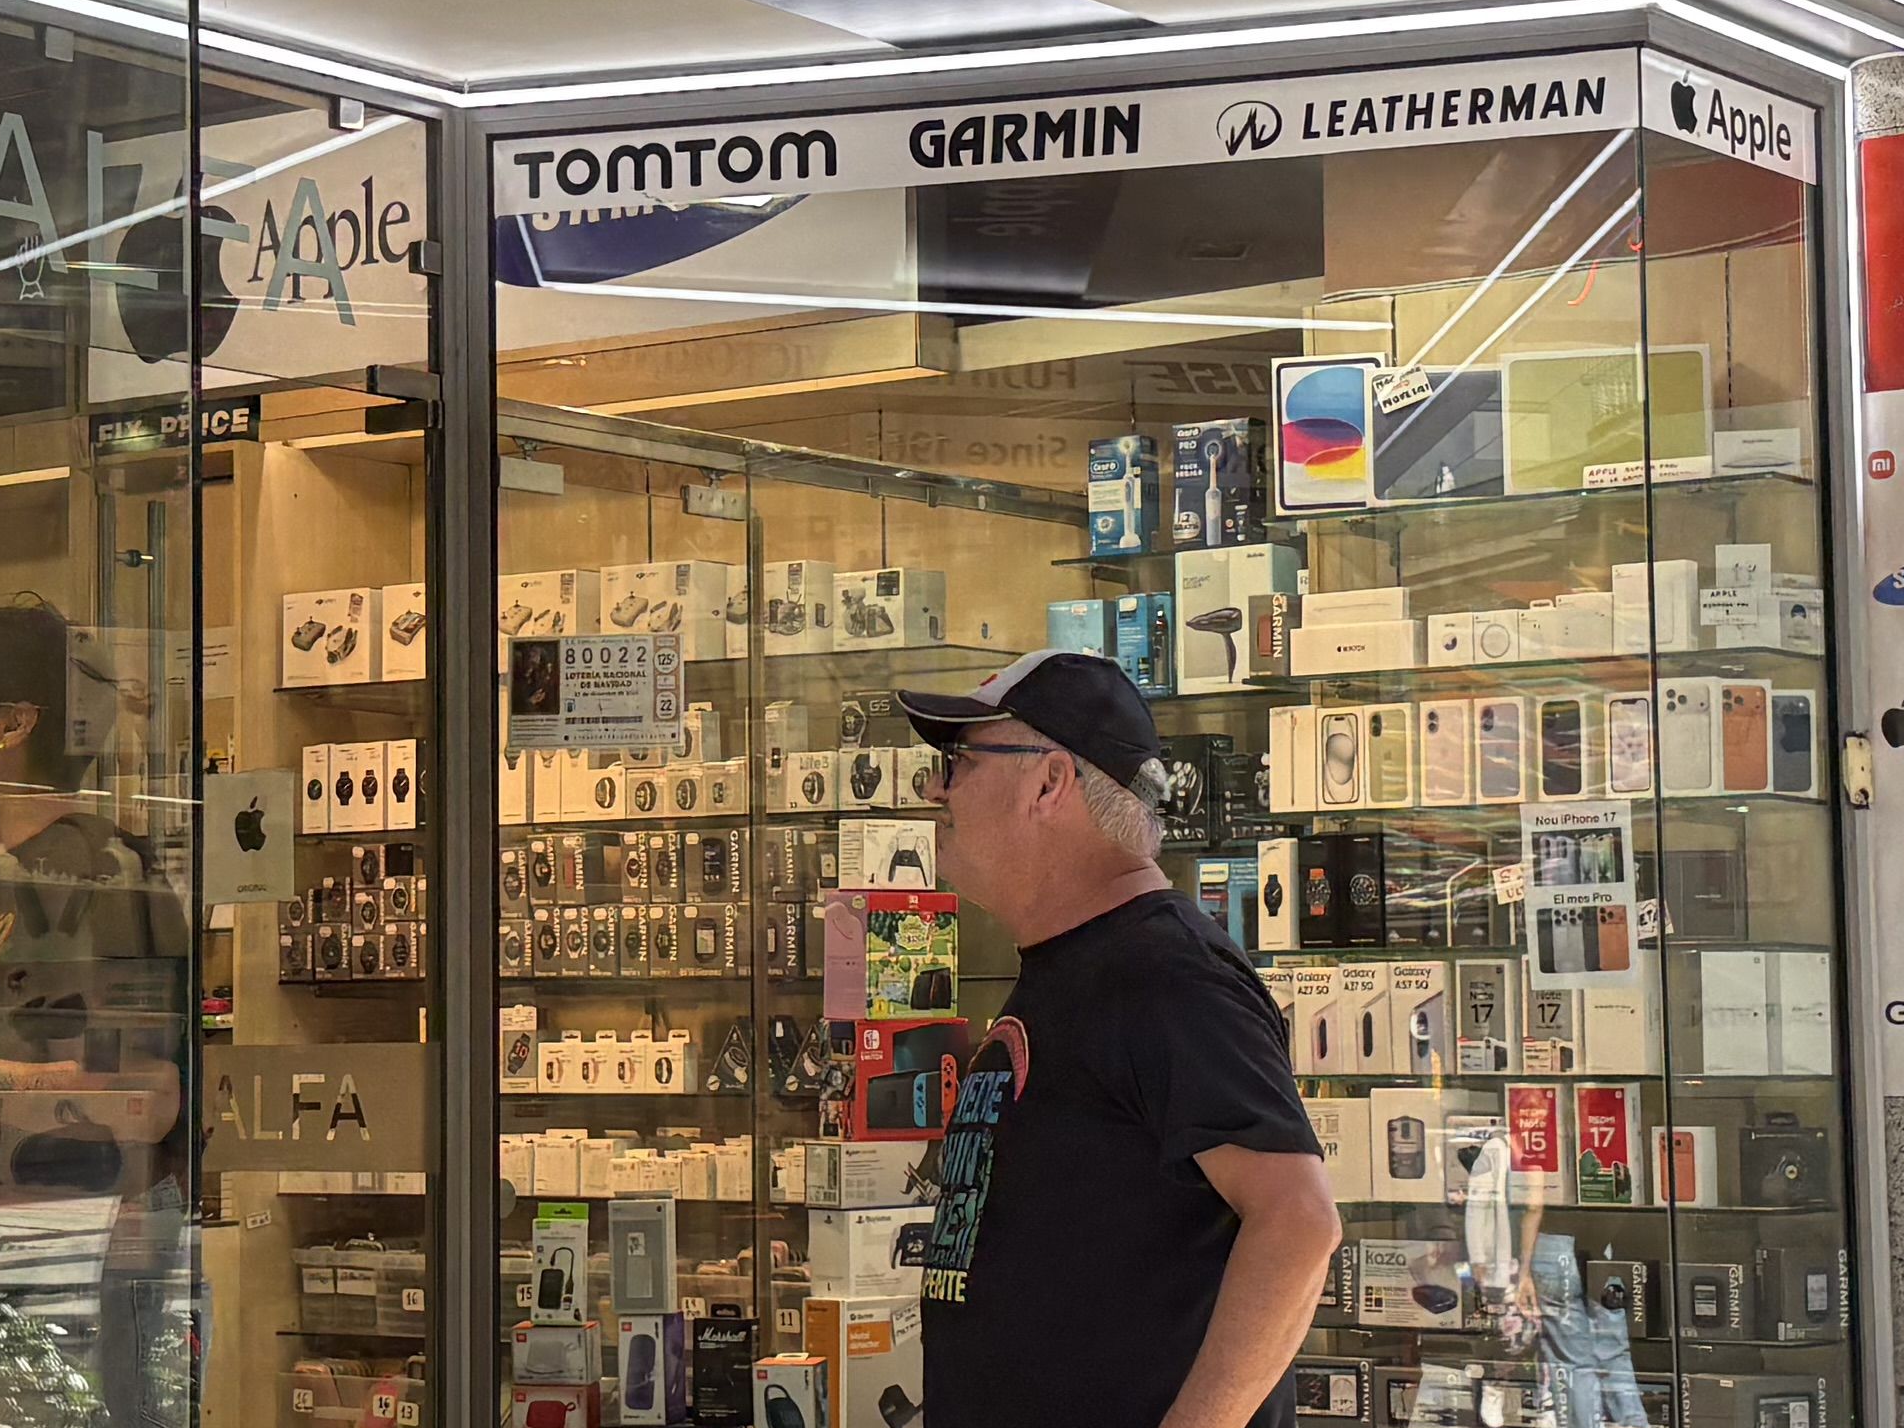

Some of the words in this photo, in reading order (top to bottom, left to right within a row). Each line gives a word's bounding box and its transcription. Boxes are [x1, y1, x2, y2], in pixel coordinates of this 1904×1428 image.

[909, 102, 1141, 170] GARMIN
[1302, 76, 1607, 142] LEATHERMAN
[1707, 89, 1792, 162] Apple
[246, 174, 412, 306] Apple
[565, 646, 647, 665] 80022
[1604, 811, 1617, 822] 17
[730, 829, 740, 893] GARMIN
[1593, 892, 1613, 903] Pro
[725, 905, 735, 968] GARMIN
[1470, 1004, 1494, 1024] 17
[1537, 1003, 1561, 1023] 17
[217, 1072, 371, 1142] ALFA
[1590, 1127, 1615, 1148] 17
[1521, 1131, 1546, 1152] 15
[1341, 1245, 1353, 1314] GARMIN
[1632, 1264, 1643, 1323] GARMIN
[1729, 1266, 1740, 1329] GARMIN
[1838, 1249, 1849, 1327] GARMIN
